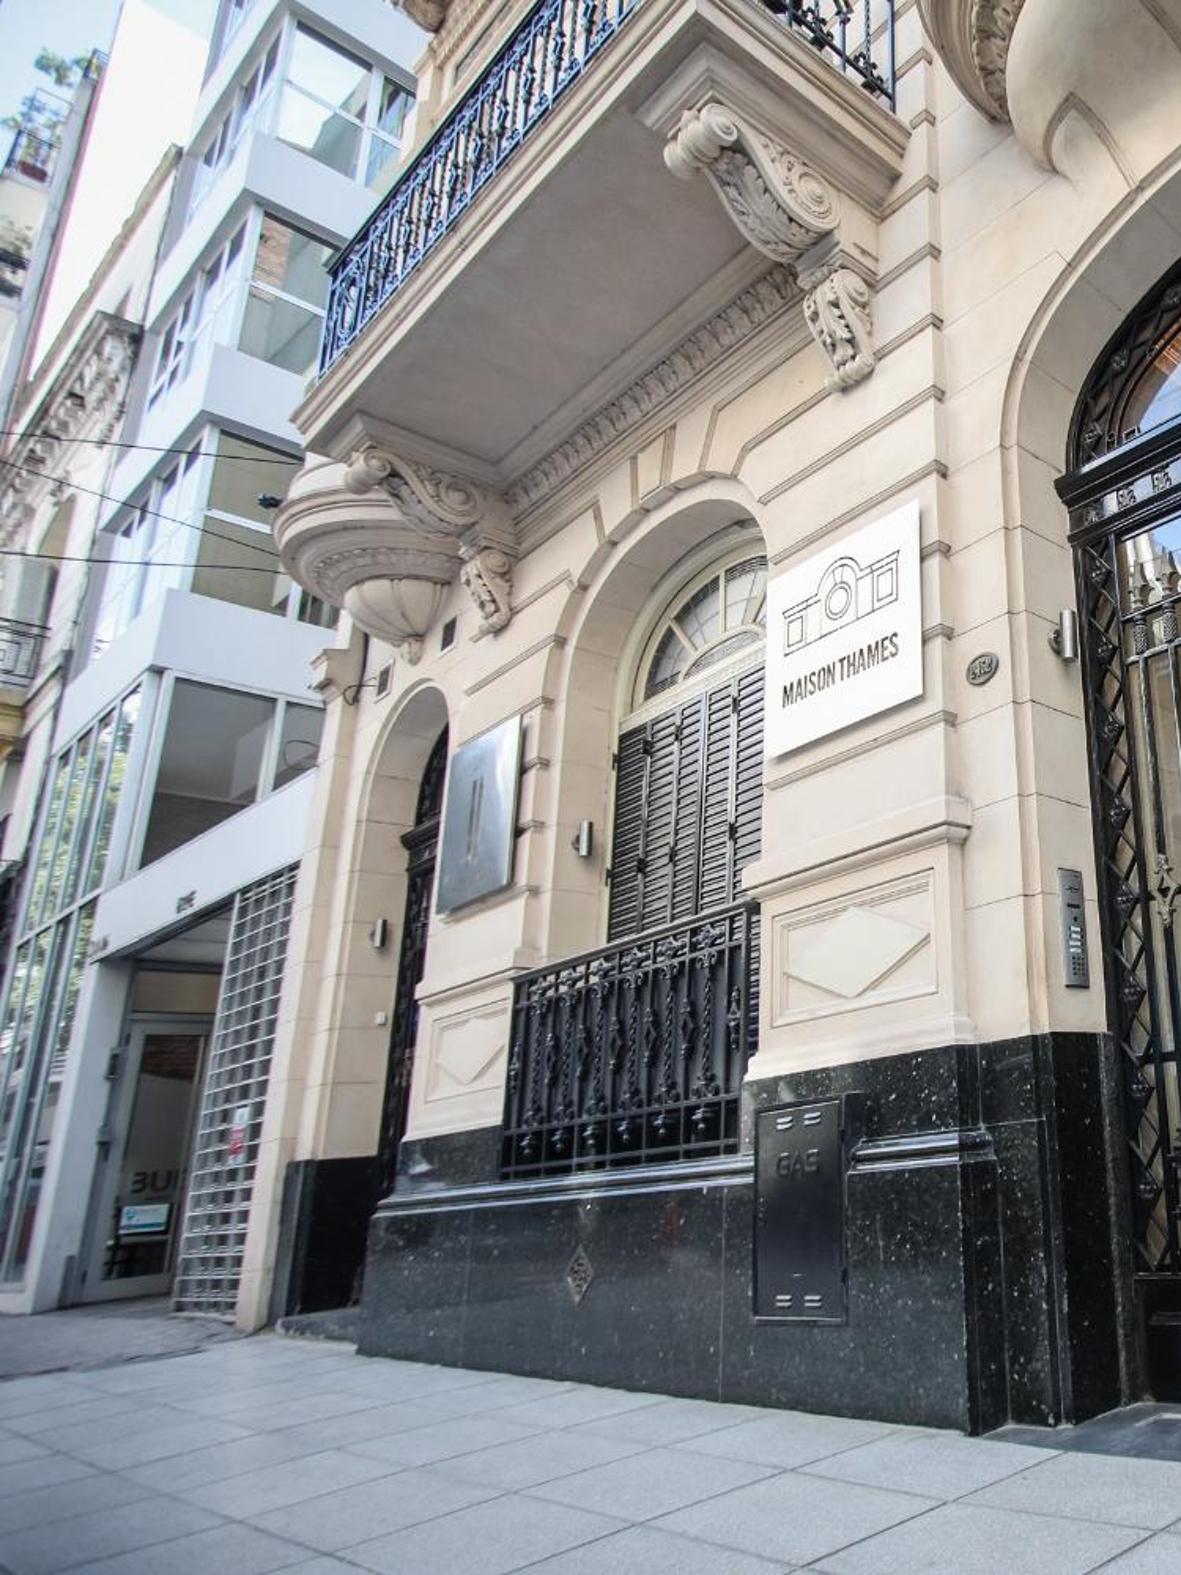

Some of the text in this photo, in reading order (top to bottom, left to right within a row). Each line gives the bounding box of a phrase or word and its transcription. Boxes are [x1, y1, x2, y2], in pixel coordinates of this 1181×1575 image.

[782, 631, 899, 709] MAISON THAMES
[776, 1148, 821, 1179] GAS
